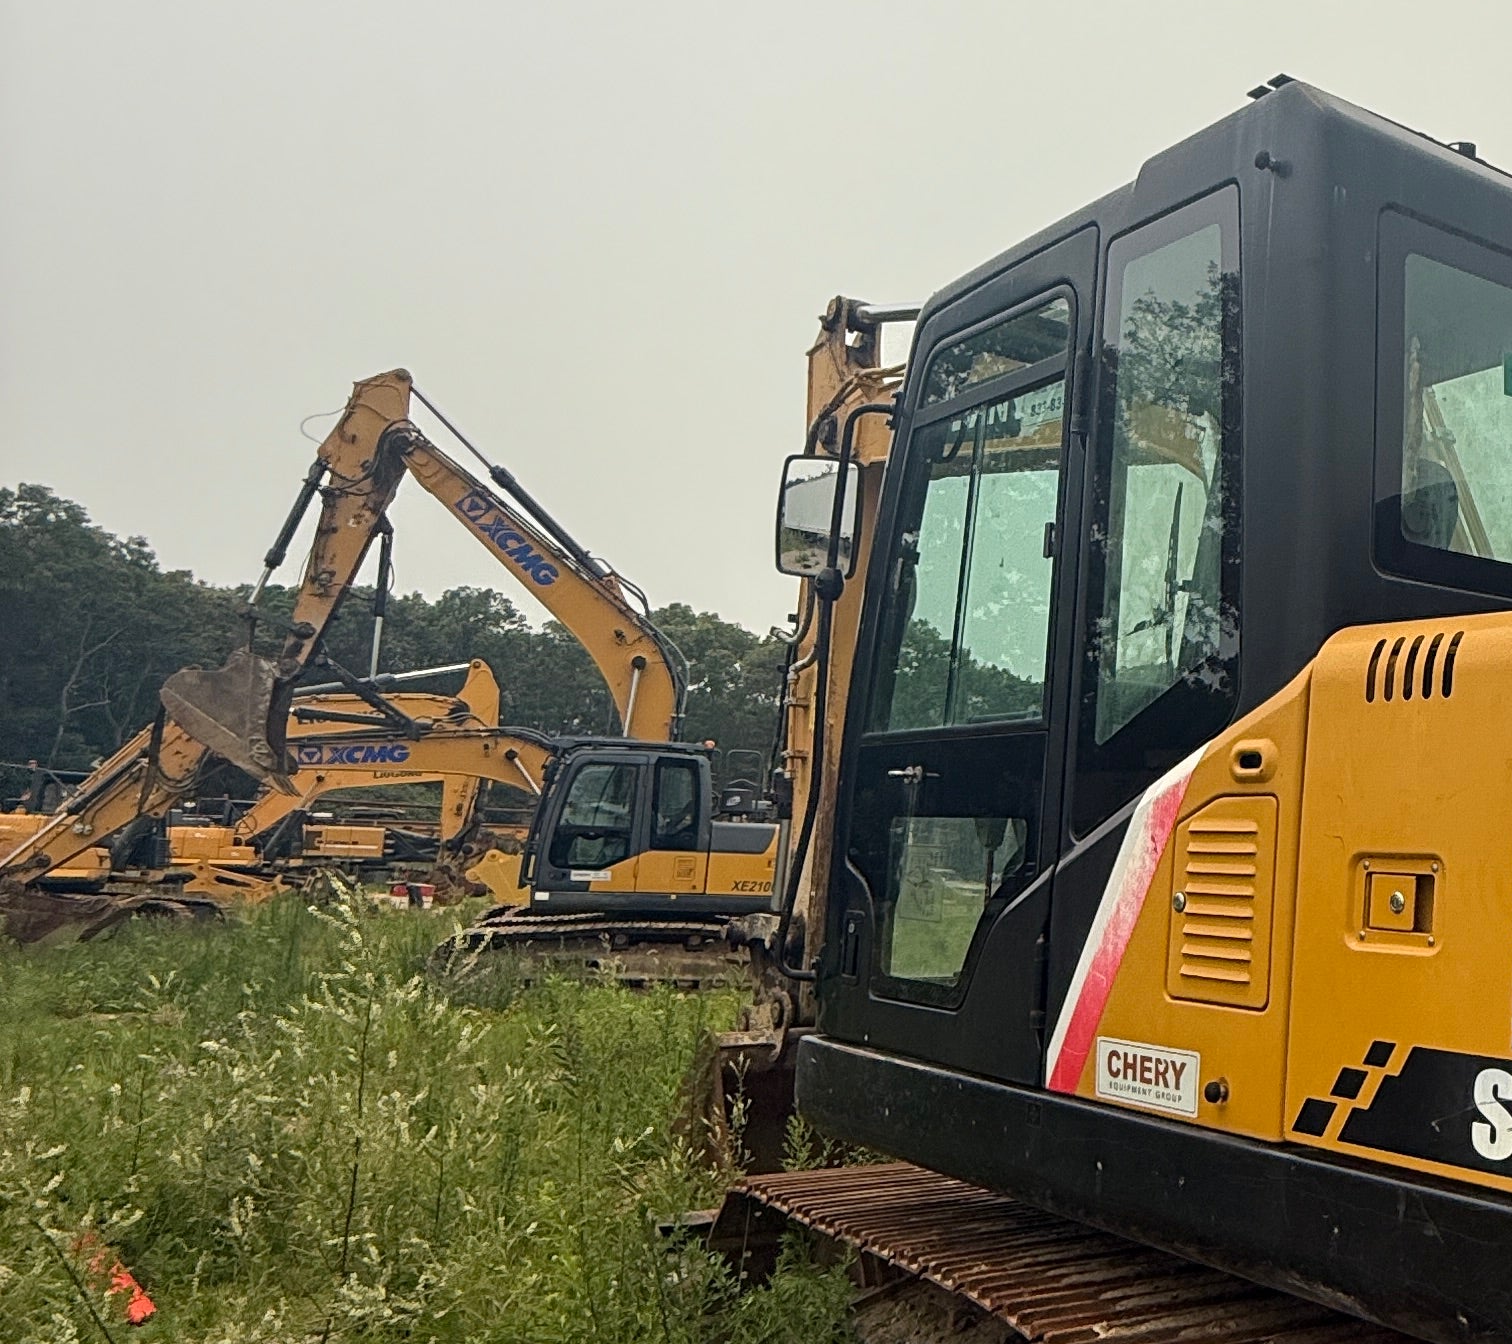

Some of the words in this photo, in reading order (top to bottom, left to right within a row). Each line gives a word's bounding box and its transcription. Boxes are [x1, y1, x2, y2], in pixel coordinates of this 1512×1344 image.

[479, 516, 559, 585] XCMG
[327, 744, 410, 765] XCMG
[731, 880, 775, 892] XE210
[1107, 1050, 1187, 1091] CHERY
[1109, 1081, 1152, 1097] EQUIPMENT
[1155, 1090, 1182, 1103] GROUP
